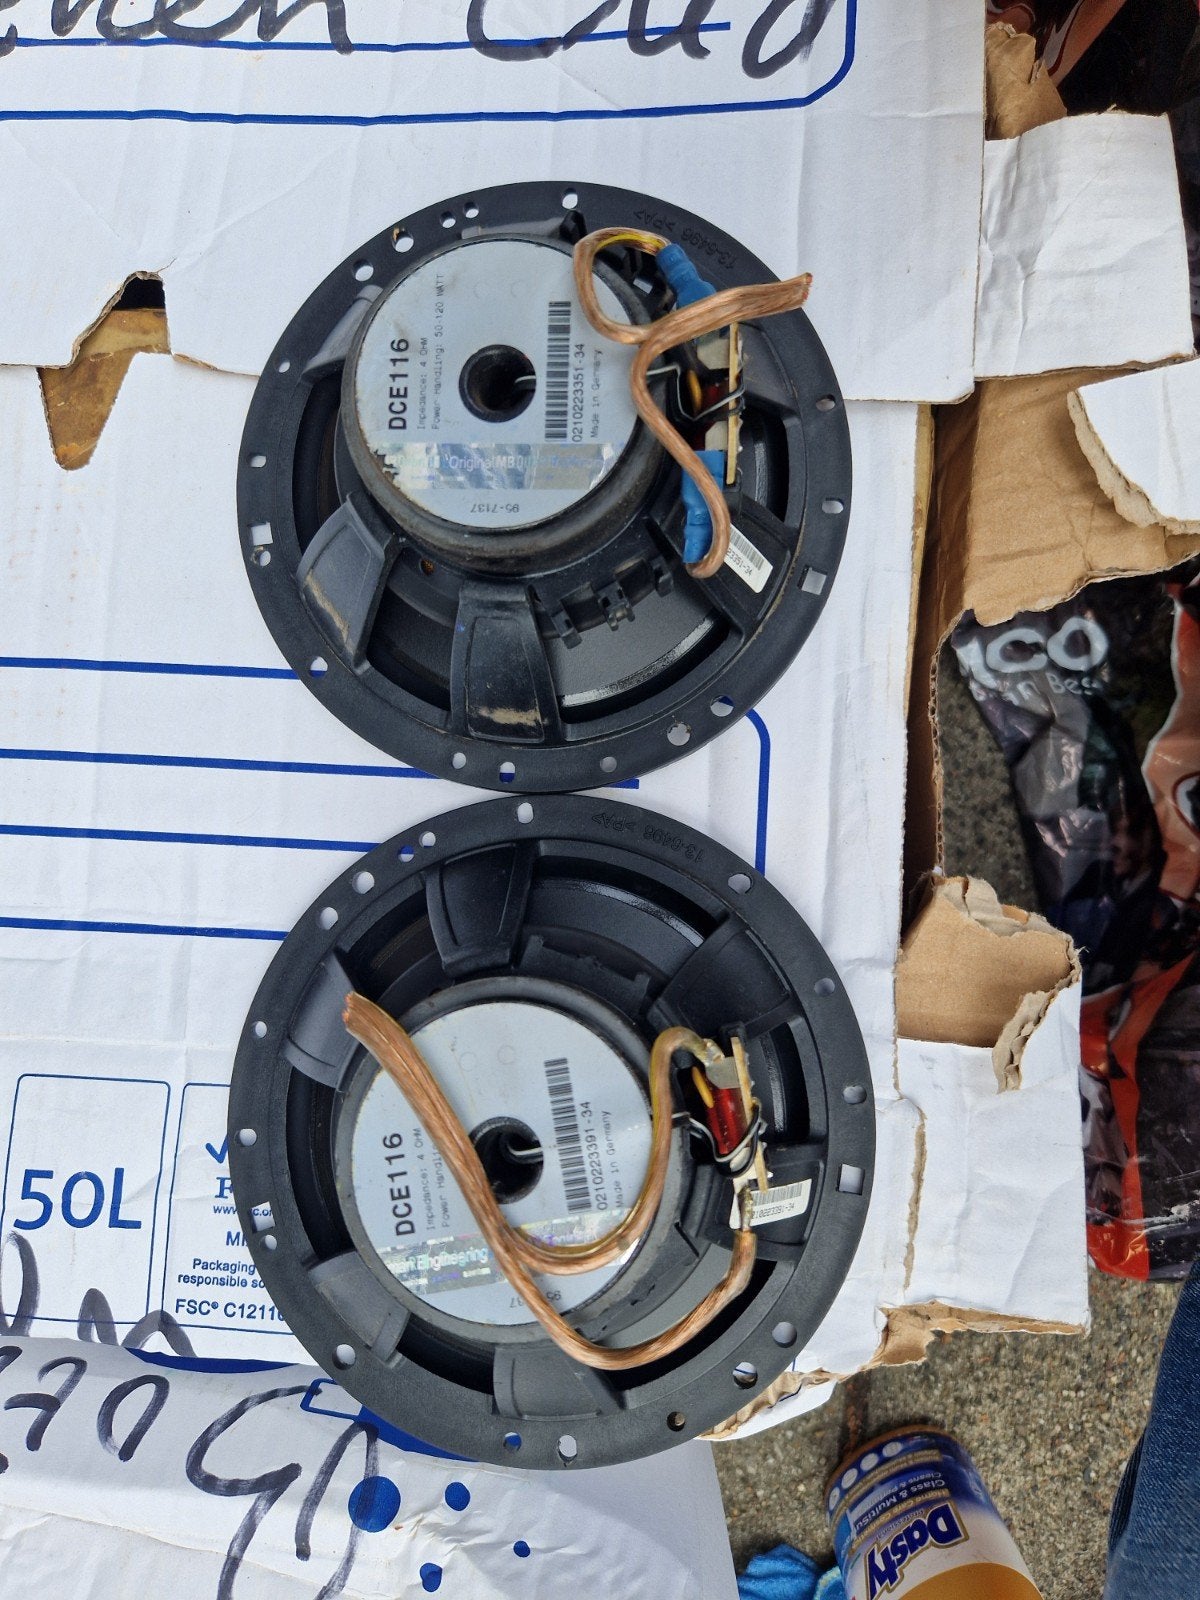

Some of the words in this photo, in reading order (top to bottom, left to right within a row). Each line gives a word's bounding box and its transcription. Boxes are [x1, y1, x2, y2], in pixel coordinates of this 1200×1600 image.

[434, 273, 445, 297] WATT
[434, 301, 445, 338] 50-120
[419, 337, 428, 356] OHM
[388, 338, 410, 430] DCE116
[433, 343, 445, 395] Handling:
[591, 348, 603, 391] Germany
[417, 375, 428, 430] Impedance:
[572, 343, 585, 443] 0210223351-34
[590, 395, 600, 408] in
[431, 400, 442, 430] Power
[590, 412, 601, 438] Made
[412, 1127, 424, 1147] OHM
[601, 1110, 617, 1156] Germany
[419, 1153, 426, 1161] 4
[580, 1101, 608, 1211] 0210223391-34
[609, 1162, 619, 1174] in
[13, 1167, 142, 1231] 50L
[383, 1133, 416, 1237] DCE116
[421, 1168, 436, 1231] Impedance:
[611, 1179, 624, 1208] Made
[437, 1195, 450, 1228] Power
[225, 1231, 247, 1247] MI
[177, 1273, 247, 1288] responsible
[251, 1280, 266, 1289] so
[192, 1258, 255, 1275] Packaging
[898, 1489, 908, 1498] &
[910, 1479, 946, 1492] Glass
[867, 1502, 963, 1600] Dasty
